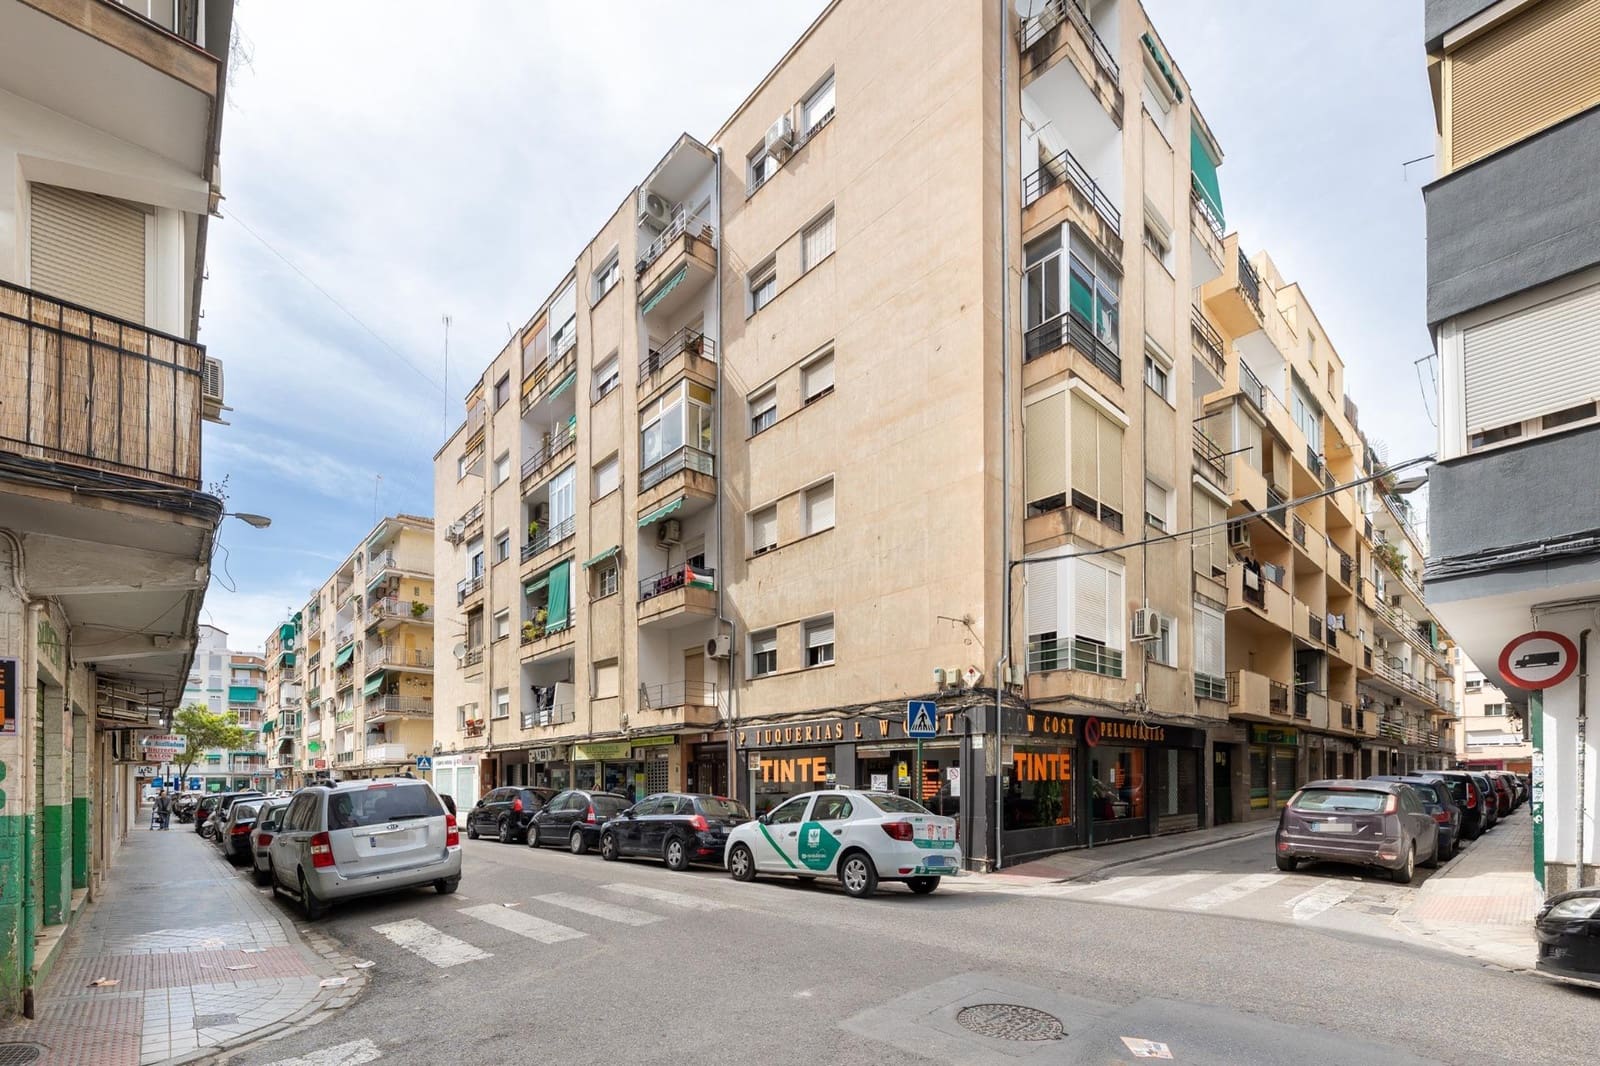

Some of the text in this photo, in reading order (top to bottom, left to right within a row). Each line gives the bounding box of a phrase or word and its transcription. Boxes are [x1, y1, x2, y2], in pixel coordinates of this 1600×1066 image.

[1043, 716, 1074, 735] COST
[760, 756, 827, 783] TINTE
[1013, 752, 1071, 781] TINTE
